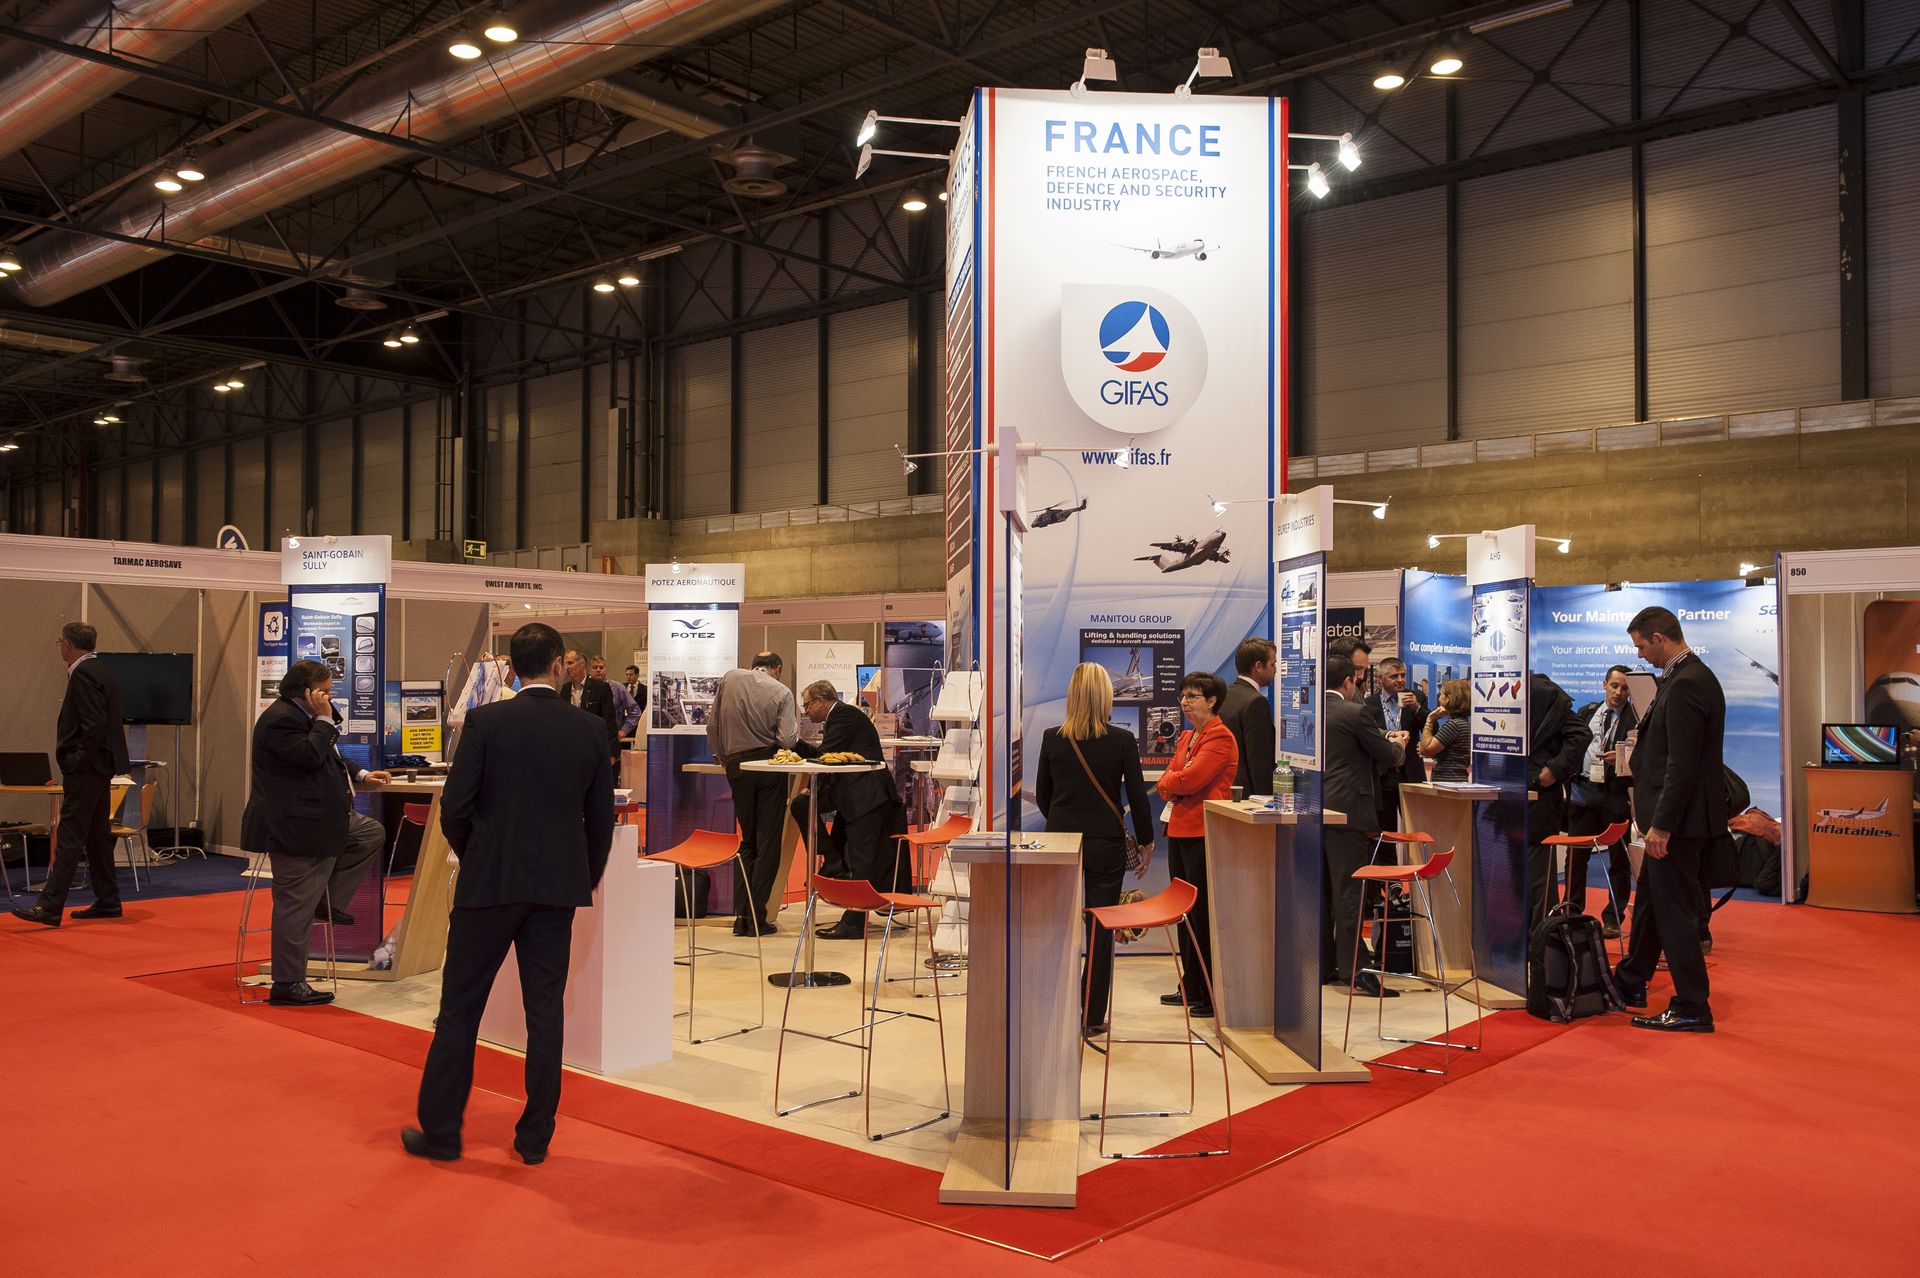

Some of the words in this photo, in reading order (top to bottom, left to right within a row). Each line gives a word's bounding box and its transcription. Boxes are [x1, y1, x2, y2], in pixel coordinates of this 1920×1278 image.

[1045, 119, 1221, 157] FRANCE
[1046, 165, 1107, 180] FRENCH
[1111, 167, 1204, 184] AEROSPACE,
[1046, 181, 1116, 196] DEFENCE
[1119, 182, 1151, 197] AND
[1154, 183, 1227, 199] SECURITY
[1046, 198, 1121, 212] INDUSTRY
[1100, 379, 1169, 407] GIFAS
[1081, 448, 1172, 466] wwwifas.fr
[1277, 522, 1290, 536] EUREP
[1291, 514, 1315, 532] INDUSTRIES
[303, 549, 364, 560] SAINT-GOBAIN
[1489, 551, 1501, 560] AHG
[113, 557, 144, 567] TARMAC
[145, 558, 182, 569] AEROSAVE
[303, 561, 327, 570] SULLY
[1790, 567, 1807, 576] 850
[485, 580, 504, 588] QWEST
[504, 580, 514, 588] AIR
[676, 578, 736, 587] AERONAUTIQUE
[1090, 614, 1136, 623] MANITOU
[1138, 615, 1172, 624] GROUP
[1552, 611, 1582, 623] Your
[1586, 610, 1635, 622] Mainte
[1677, 608, 1731, 621] Partner
[1326, 621, 1362, 637] ated
[1084, 632, 1108, 640] Lifting
[1116, 632, 1147, 640] handling
[1410, 641, 1420, 651] Our
[1420, 642, 1444, 654] complete
[1444, 644, 1472, 654] maintenanc
[1552, 644, 1572, 655] Your
[1575, 644, 1611, 655] aircraft.
[1812, 824, 1894, 838] Inflatables
